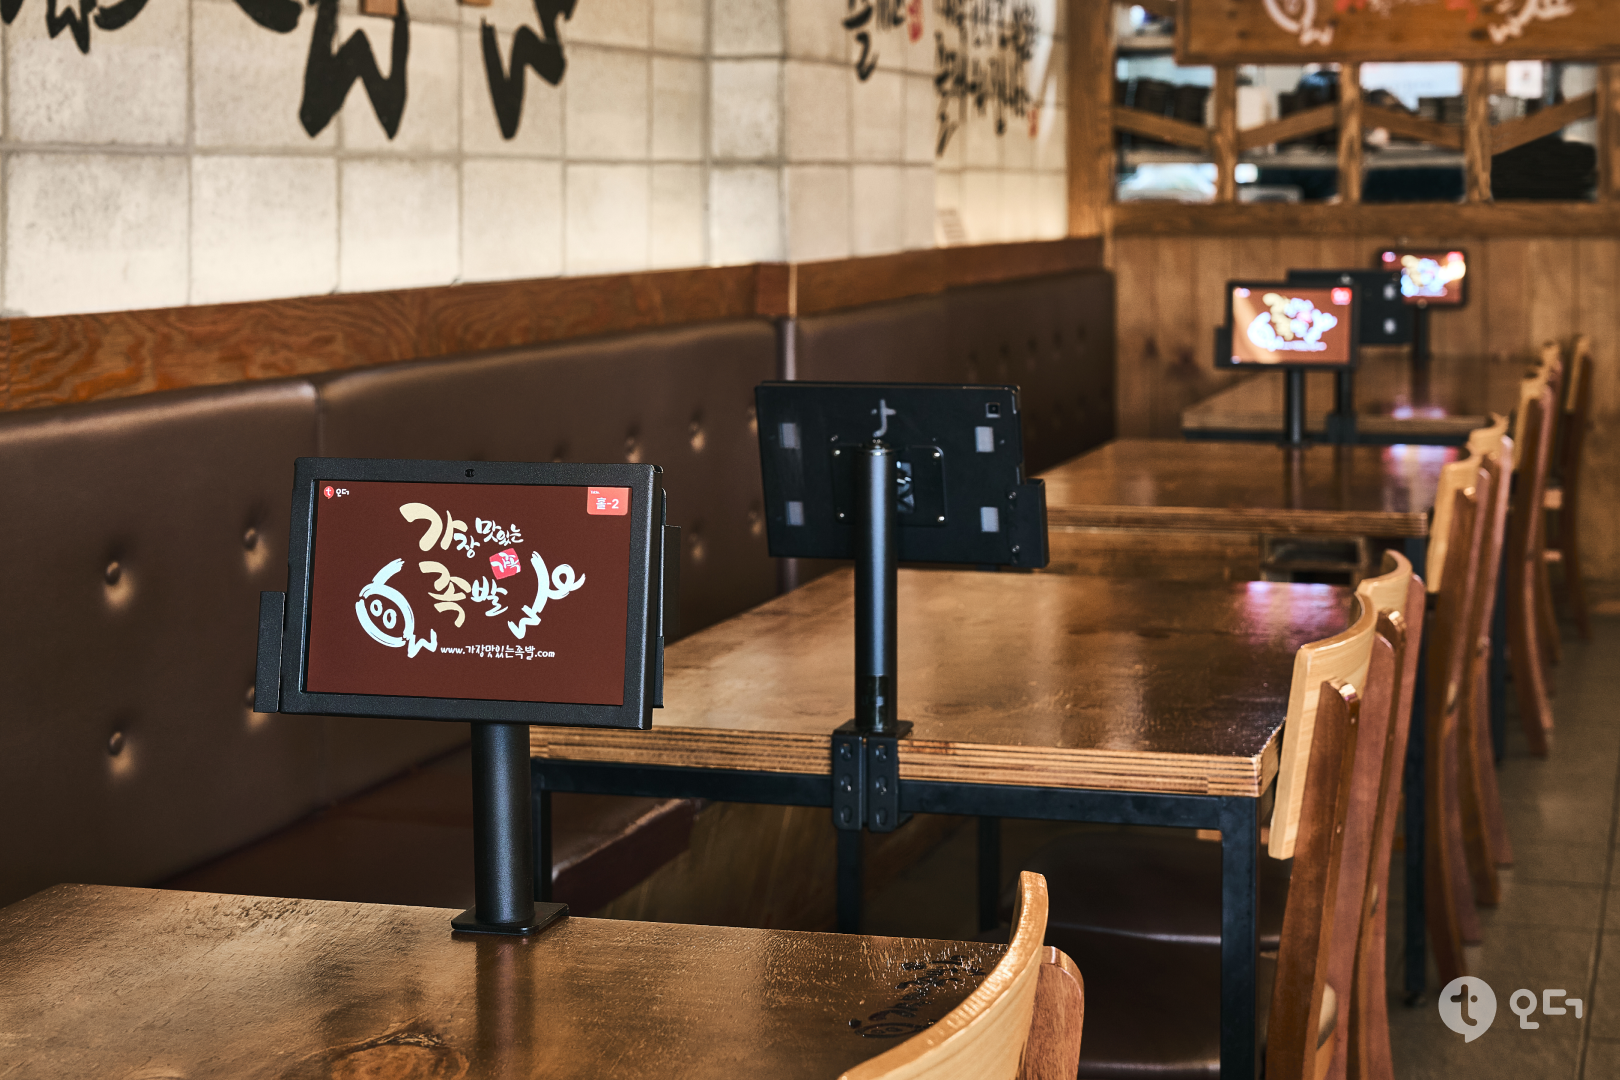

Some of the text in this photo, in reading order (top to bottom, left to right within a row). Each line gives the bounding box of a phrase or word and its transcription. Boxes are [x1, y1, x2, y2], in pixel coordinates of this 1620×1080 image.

[596, 497, 620, 510] 홀-2
[399, 502, 524, 558] 가장 맛있는
[418, 561, 508, 628] 족발
[440, 644, 556, 661] www.가장맛있는족발.com
